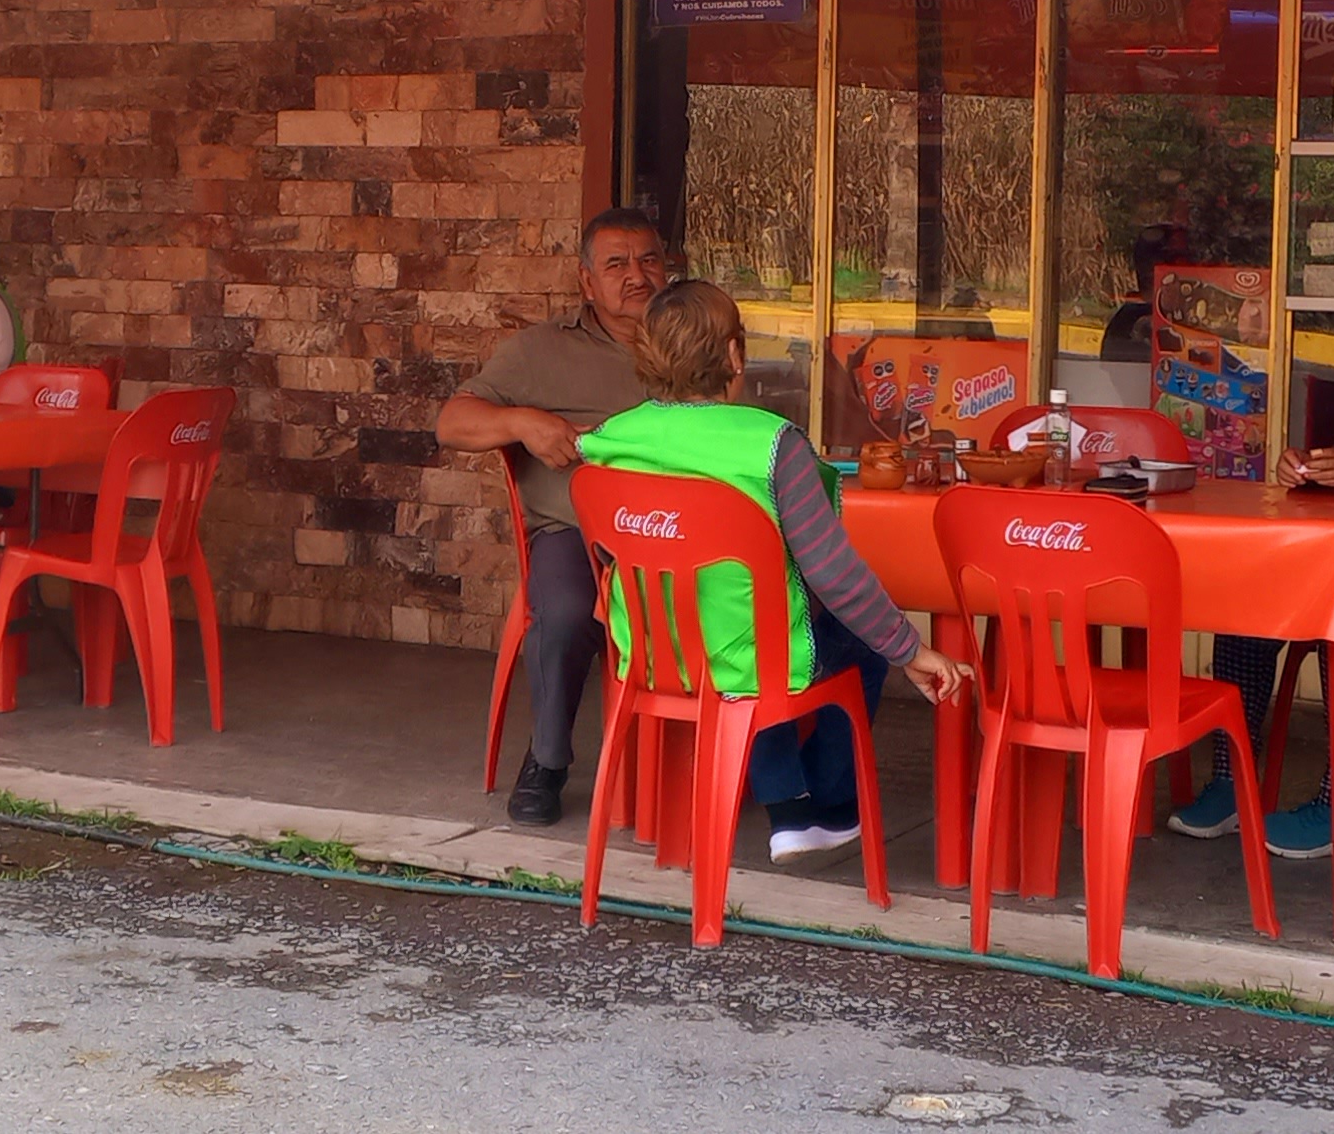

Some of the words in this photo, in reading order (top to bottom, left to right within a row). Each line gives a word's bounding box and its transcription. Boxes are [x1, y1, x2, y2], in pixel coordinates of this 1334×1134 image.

[673, 3, 680, 11] Y
[681, 2, 701, 11] NOS
[702, 0, 749, 10] CUIDAMOS
[954, 379, 972, 403] Se
[973, 368, 1006, 399] pasa
[970, 376, 1013, 417] bueno!
[613, 506, 681, 539] Coca-Cola
[1004, 517, 1089, 551] Coca-Cola
